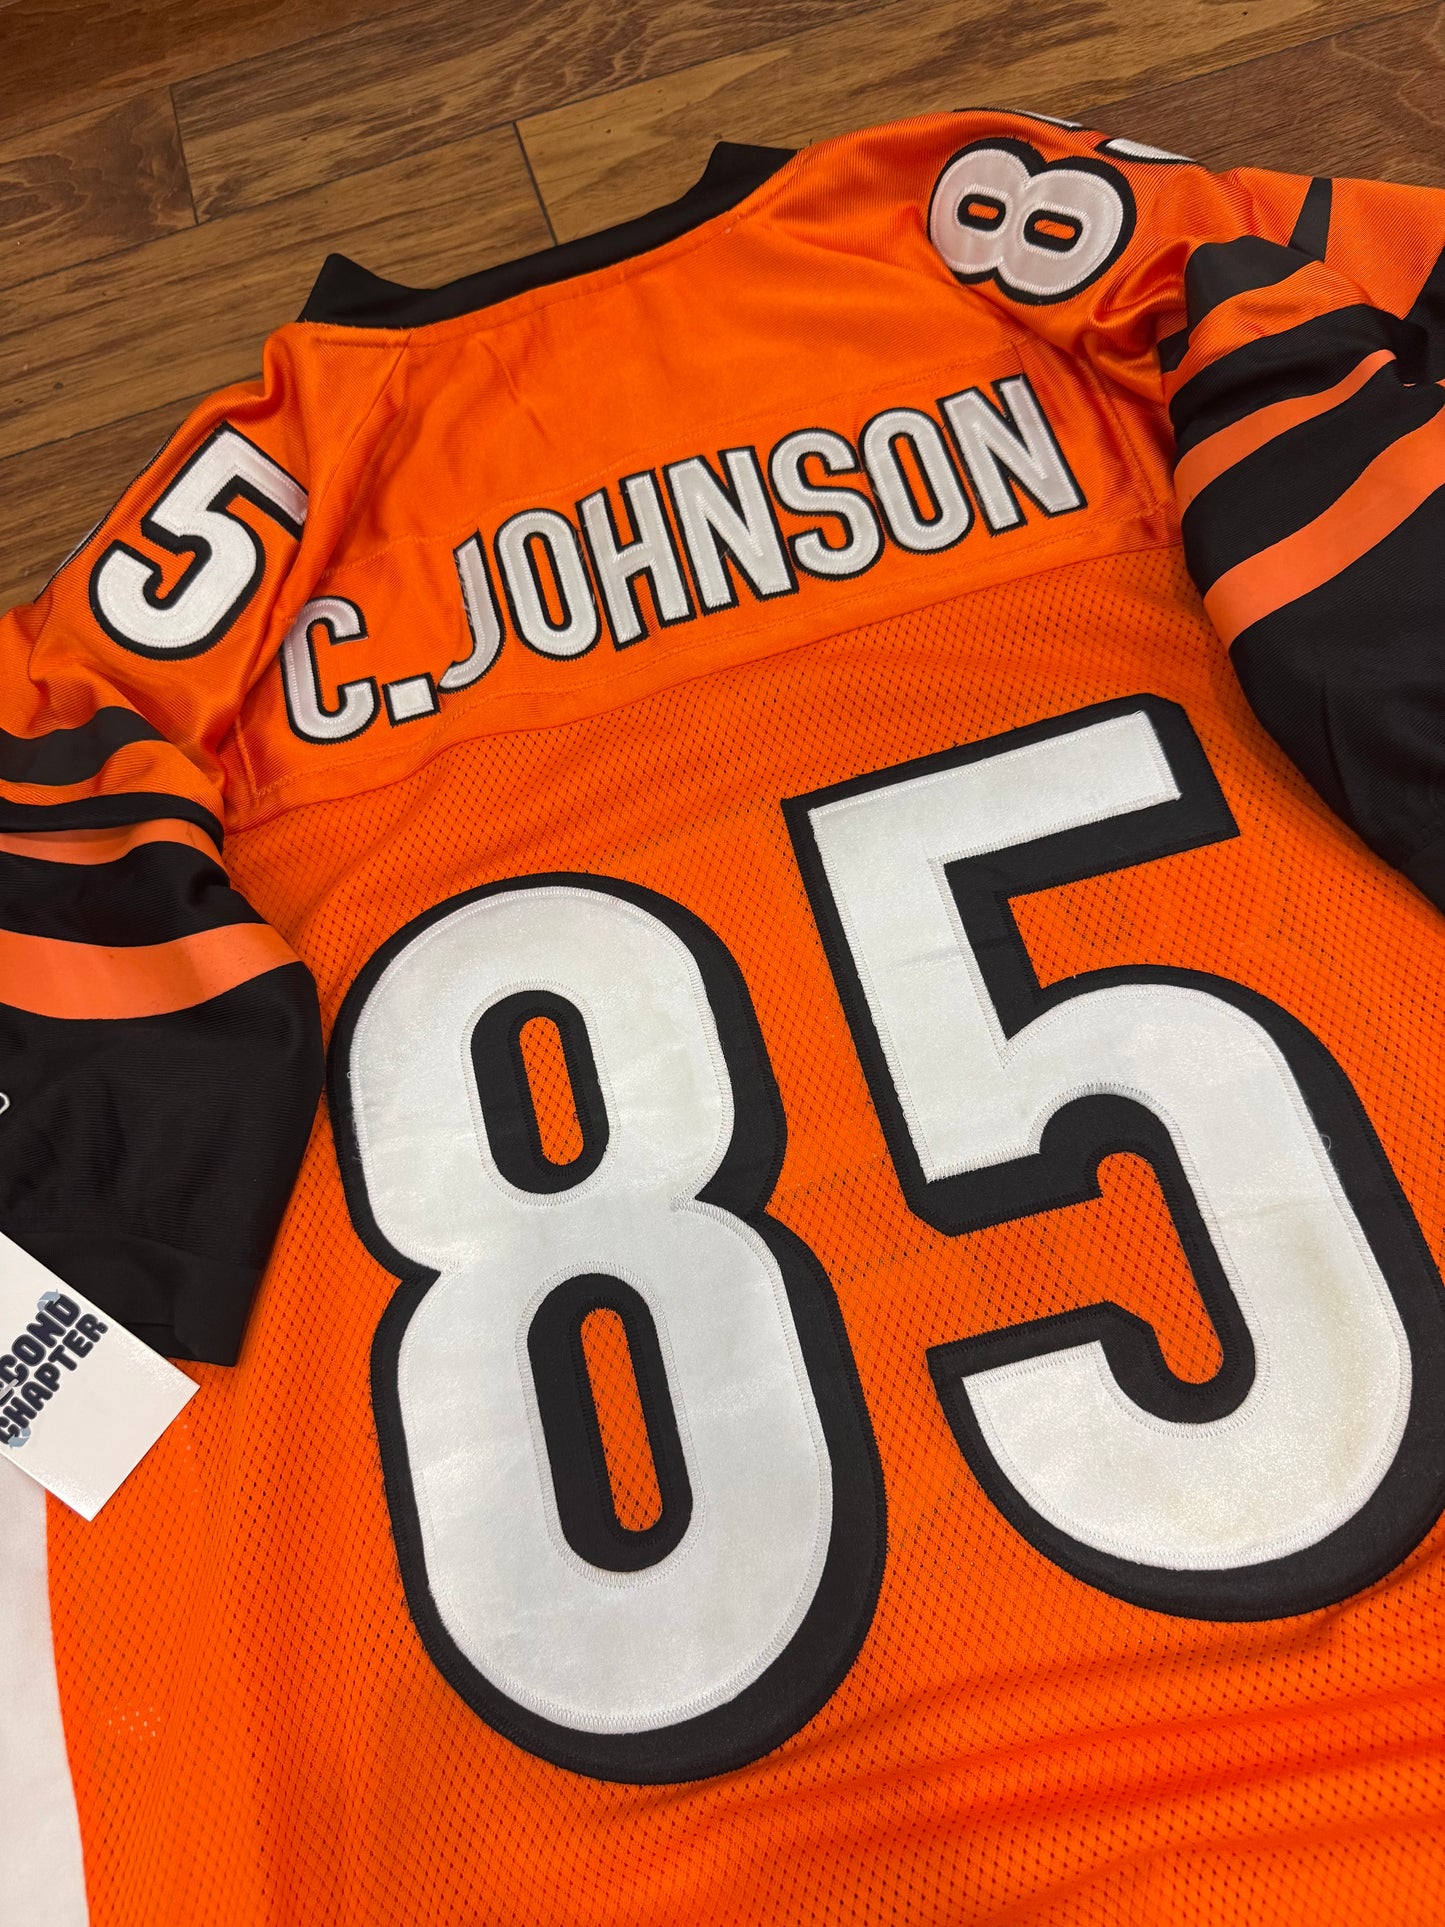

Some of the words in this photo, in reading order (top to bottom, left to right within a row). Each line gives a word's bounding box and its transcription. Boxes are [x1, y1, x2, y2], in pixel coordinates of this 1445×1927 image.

[928, 107, 1203, 304] 8
[60, 421, 309, 660] 5
[280, 374, 1087, 744] C.JOHNSON
[327, 692, 1445, 1784] 85
[0, 1314, 108, 1445] CHAPTER
